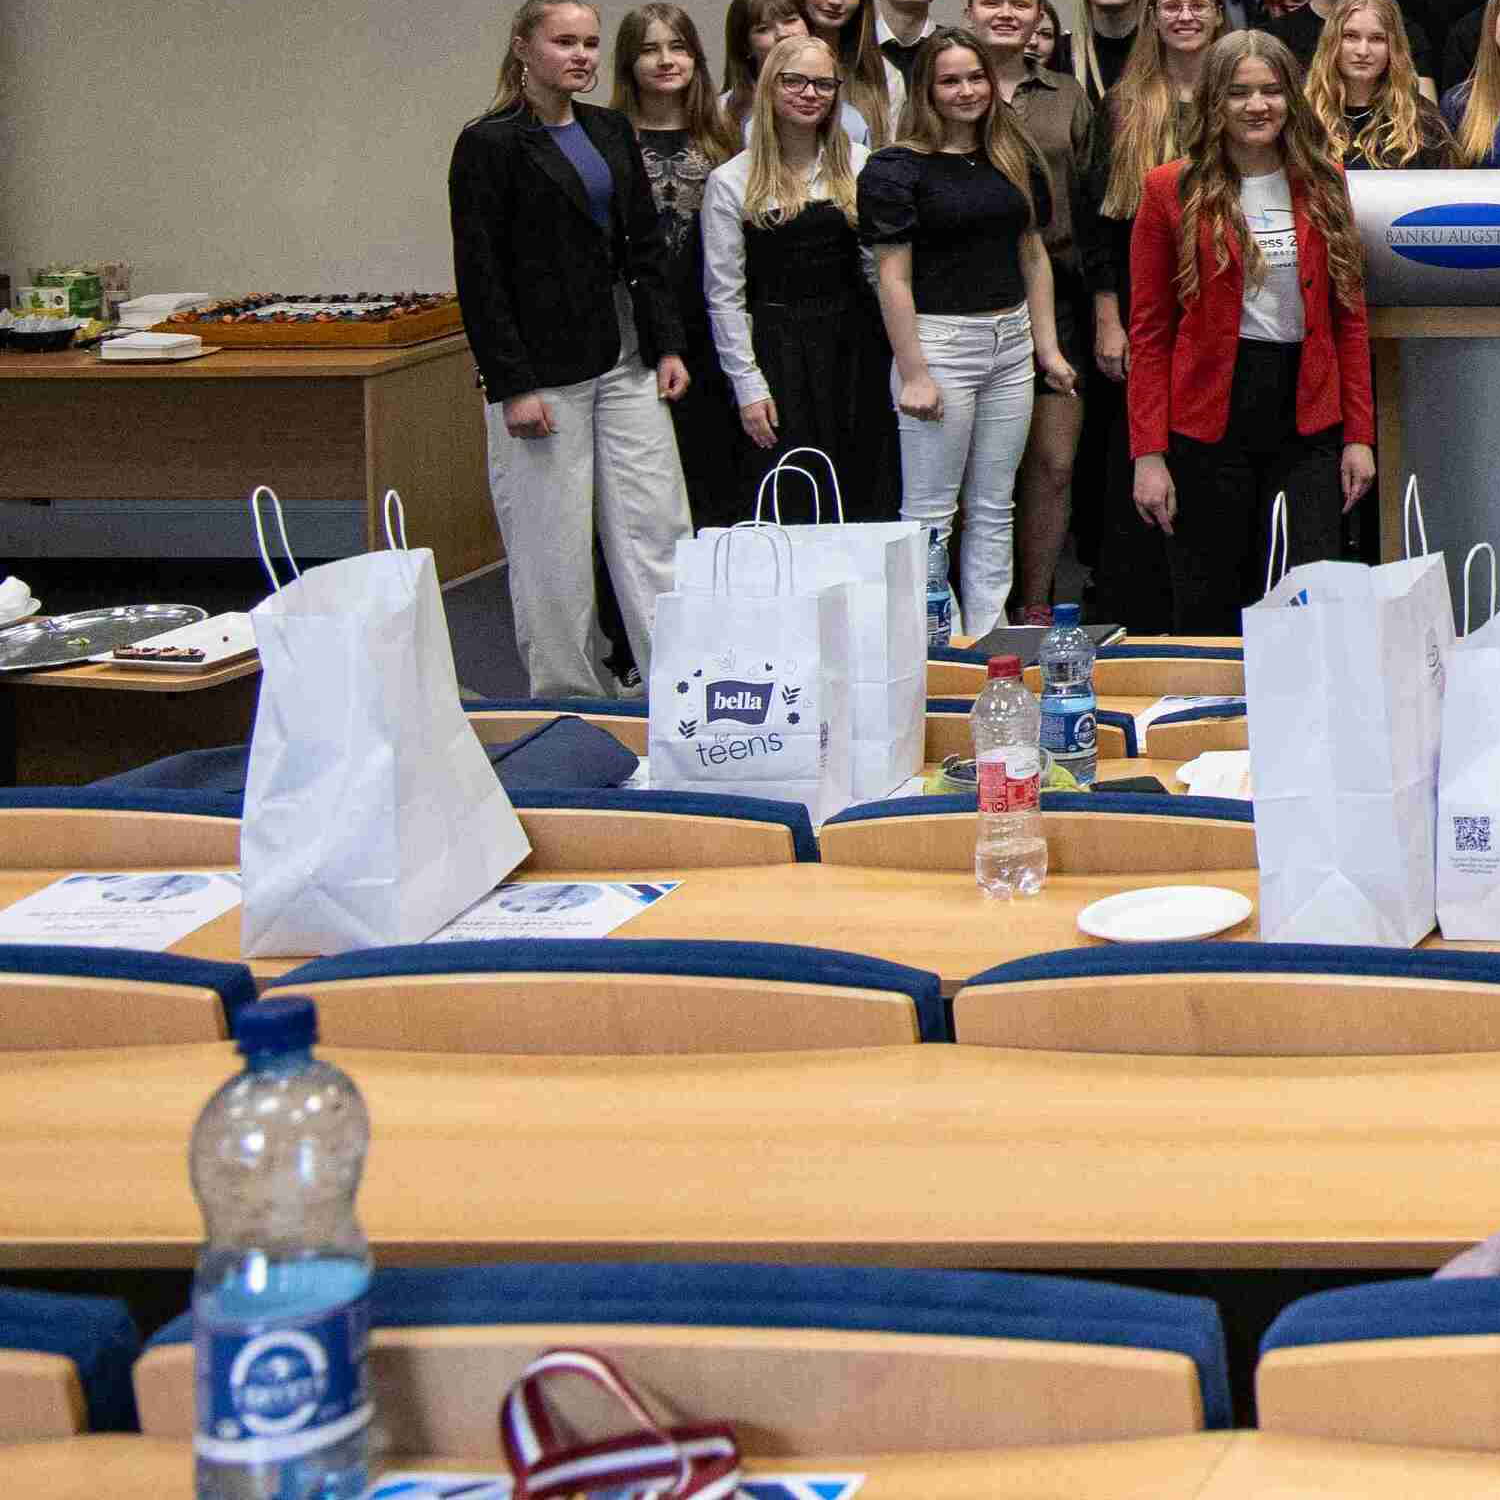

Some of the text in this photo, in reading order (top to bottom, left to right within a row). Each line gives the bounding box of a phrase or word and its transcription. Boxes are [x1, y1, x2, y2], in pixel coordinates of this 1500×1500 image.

[1385, 228, 1443, 243] BANKU
[714, 692, 763, 710] bella
[696, 732, 784, 767] teens
